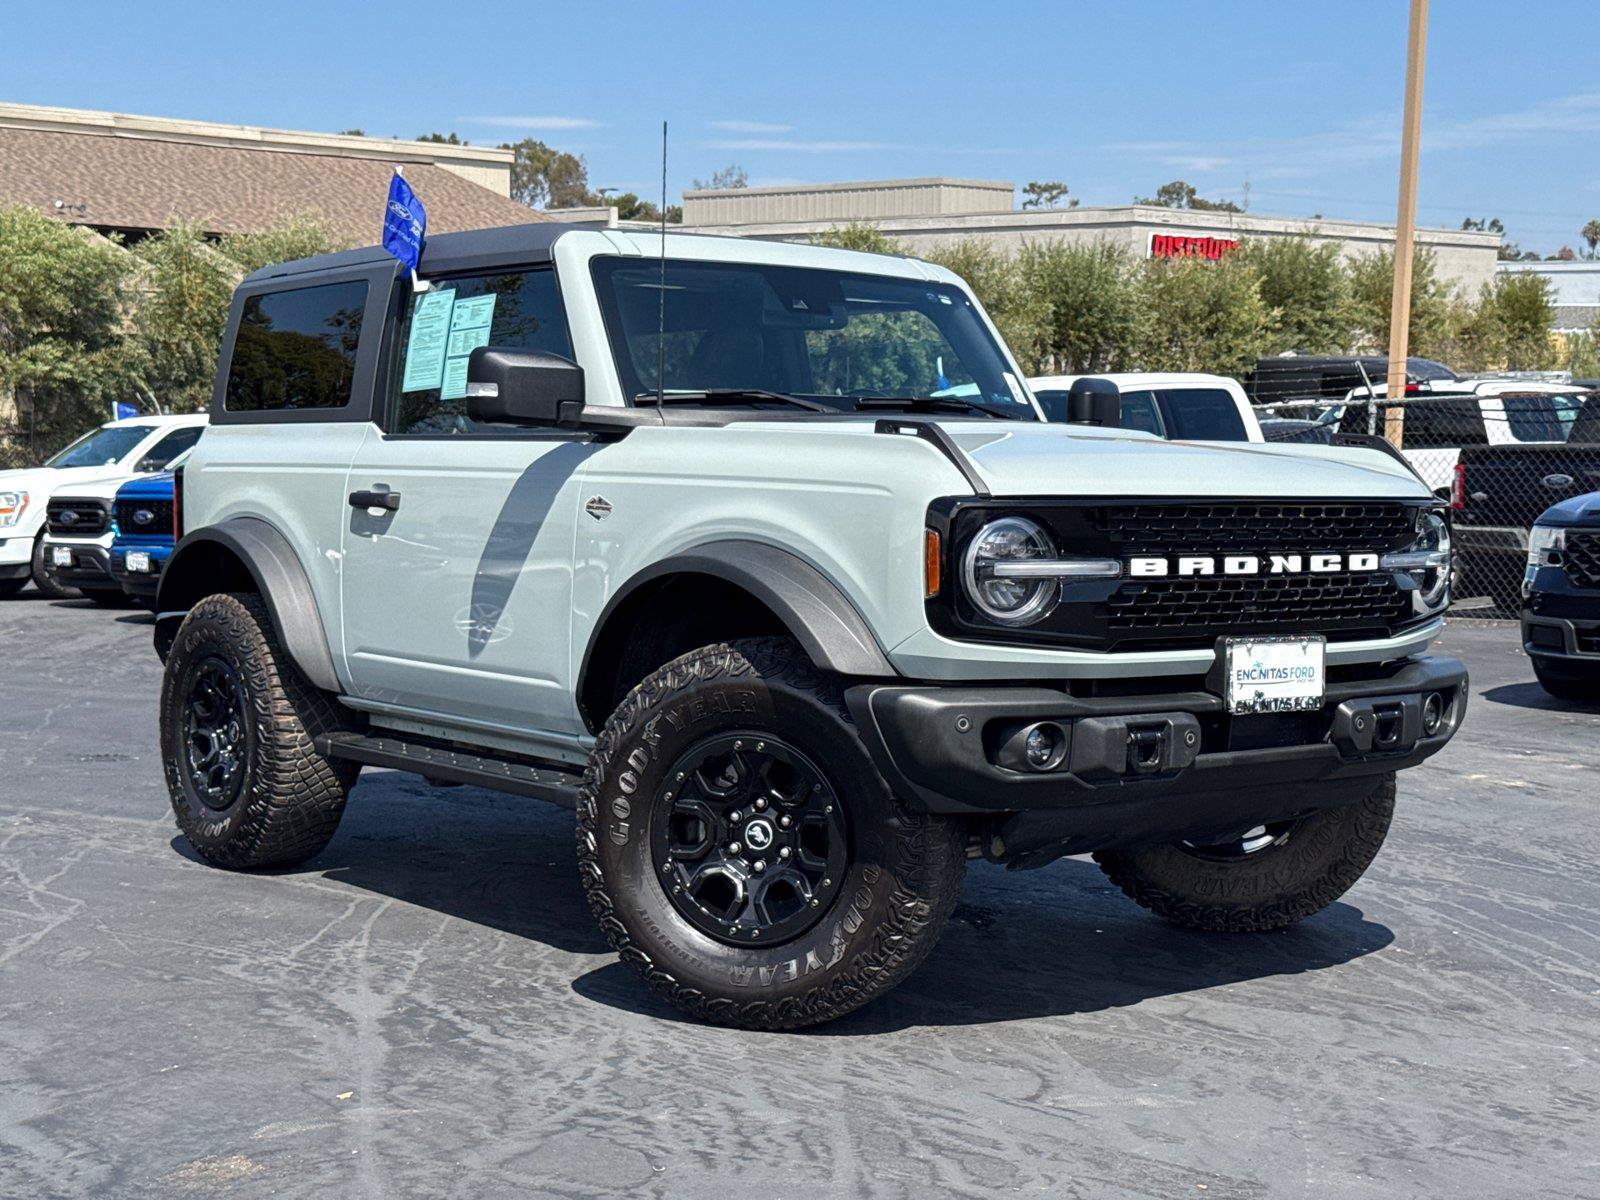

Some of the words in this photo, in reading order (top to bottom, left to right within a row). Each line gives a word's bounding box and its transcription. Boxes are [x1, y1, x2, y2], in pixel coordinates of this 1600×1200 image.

[1131, 554, 1379, 576] BRONCO
[1236, 668, 1288, 681] ENCINITAS
[1289, 666, 1315, 679] FORD
